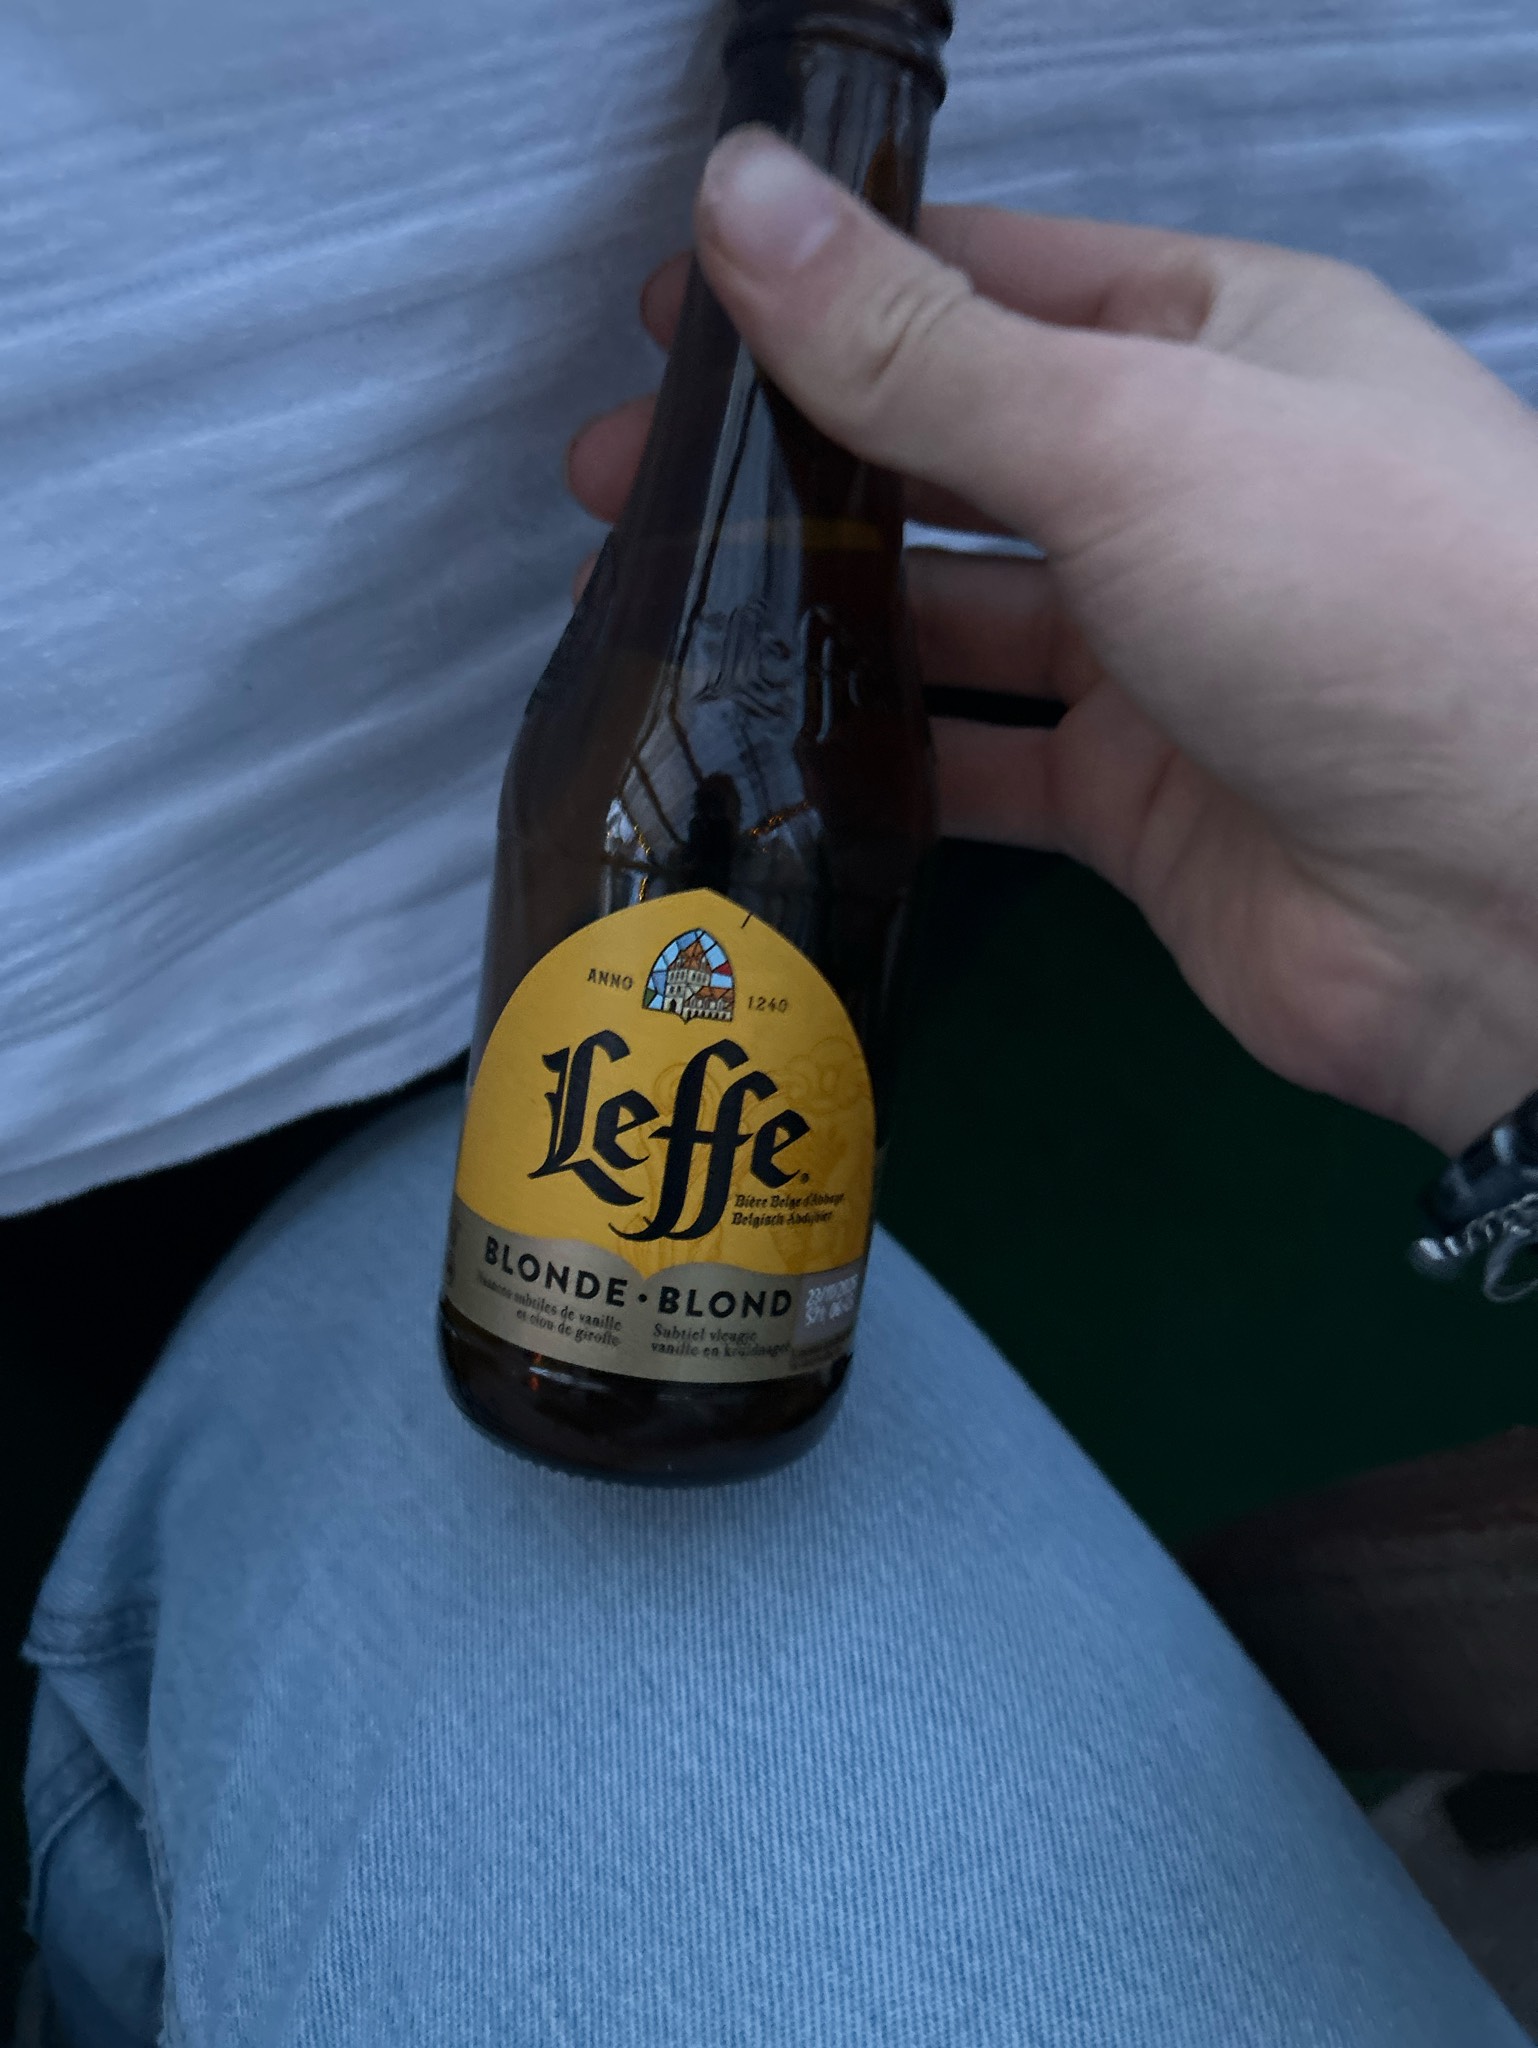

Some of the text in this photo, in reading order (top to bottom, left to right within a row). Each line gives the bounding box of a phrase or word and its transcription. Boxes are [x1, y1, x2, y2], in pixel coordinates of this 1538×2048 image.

[588, 967, 788, 1014] ANNO 1240
[527, 1029, 811, 1243] Leffe
[484, 1235, 628, 1307] BLONDE
[658, 1285, 793, 1319] BLOND
[560, 1305, 575, 1321] de
